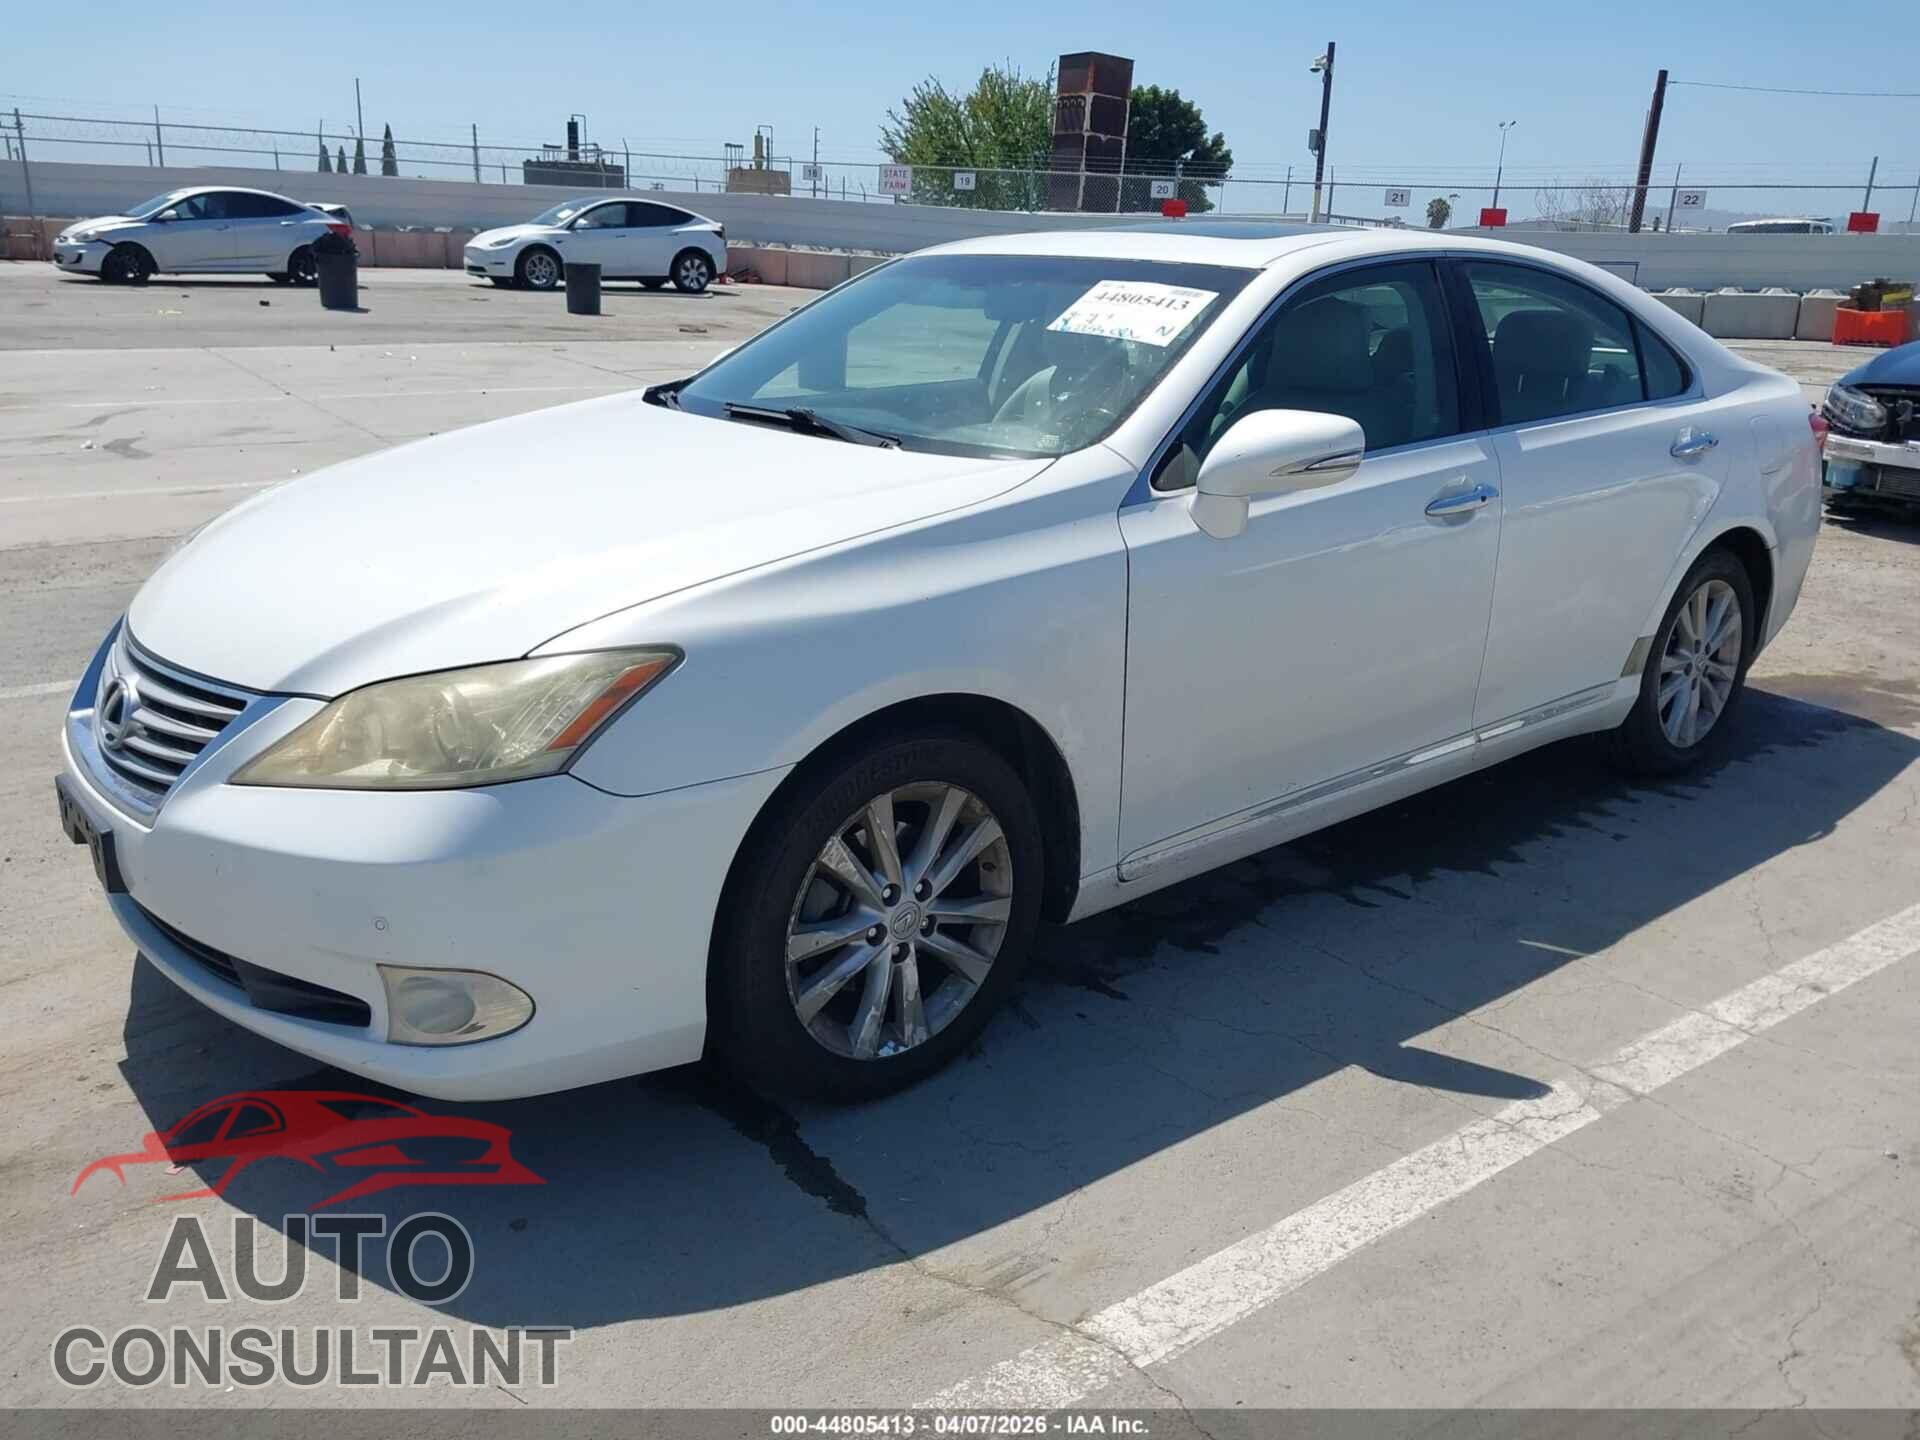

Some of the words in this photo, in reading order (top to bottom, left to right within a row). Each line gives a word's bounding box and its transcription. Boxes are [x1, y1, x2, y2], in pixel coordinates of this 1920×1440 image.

[884, 168, 908, 178] STATE
[884, 181, 906, 190] FARM
[959, 176, 970, 186] 19
[1156, 184, 1169, 194] 20
[1391, 193, 1405, 203] 21
[1683, 194, 1699, 205] 22
[1095, 291, 1190, 311] 44805413
